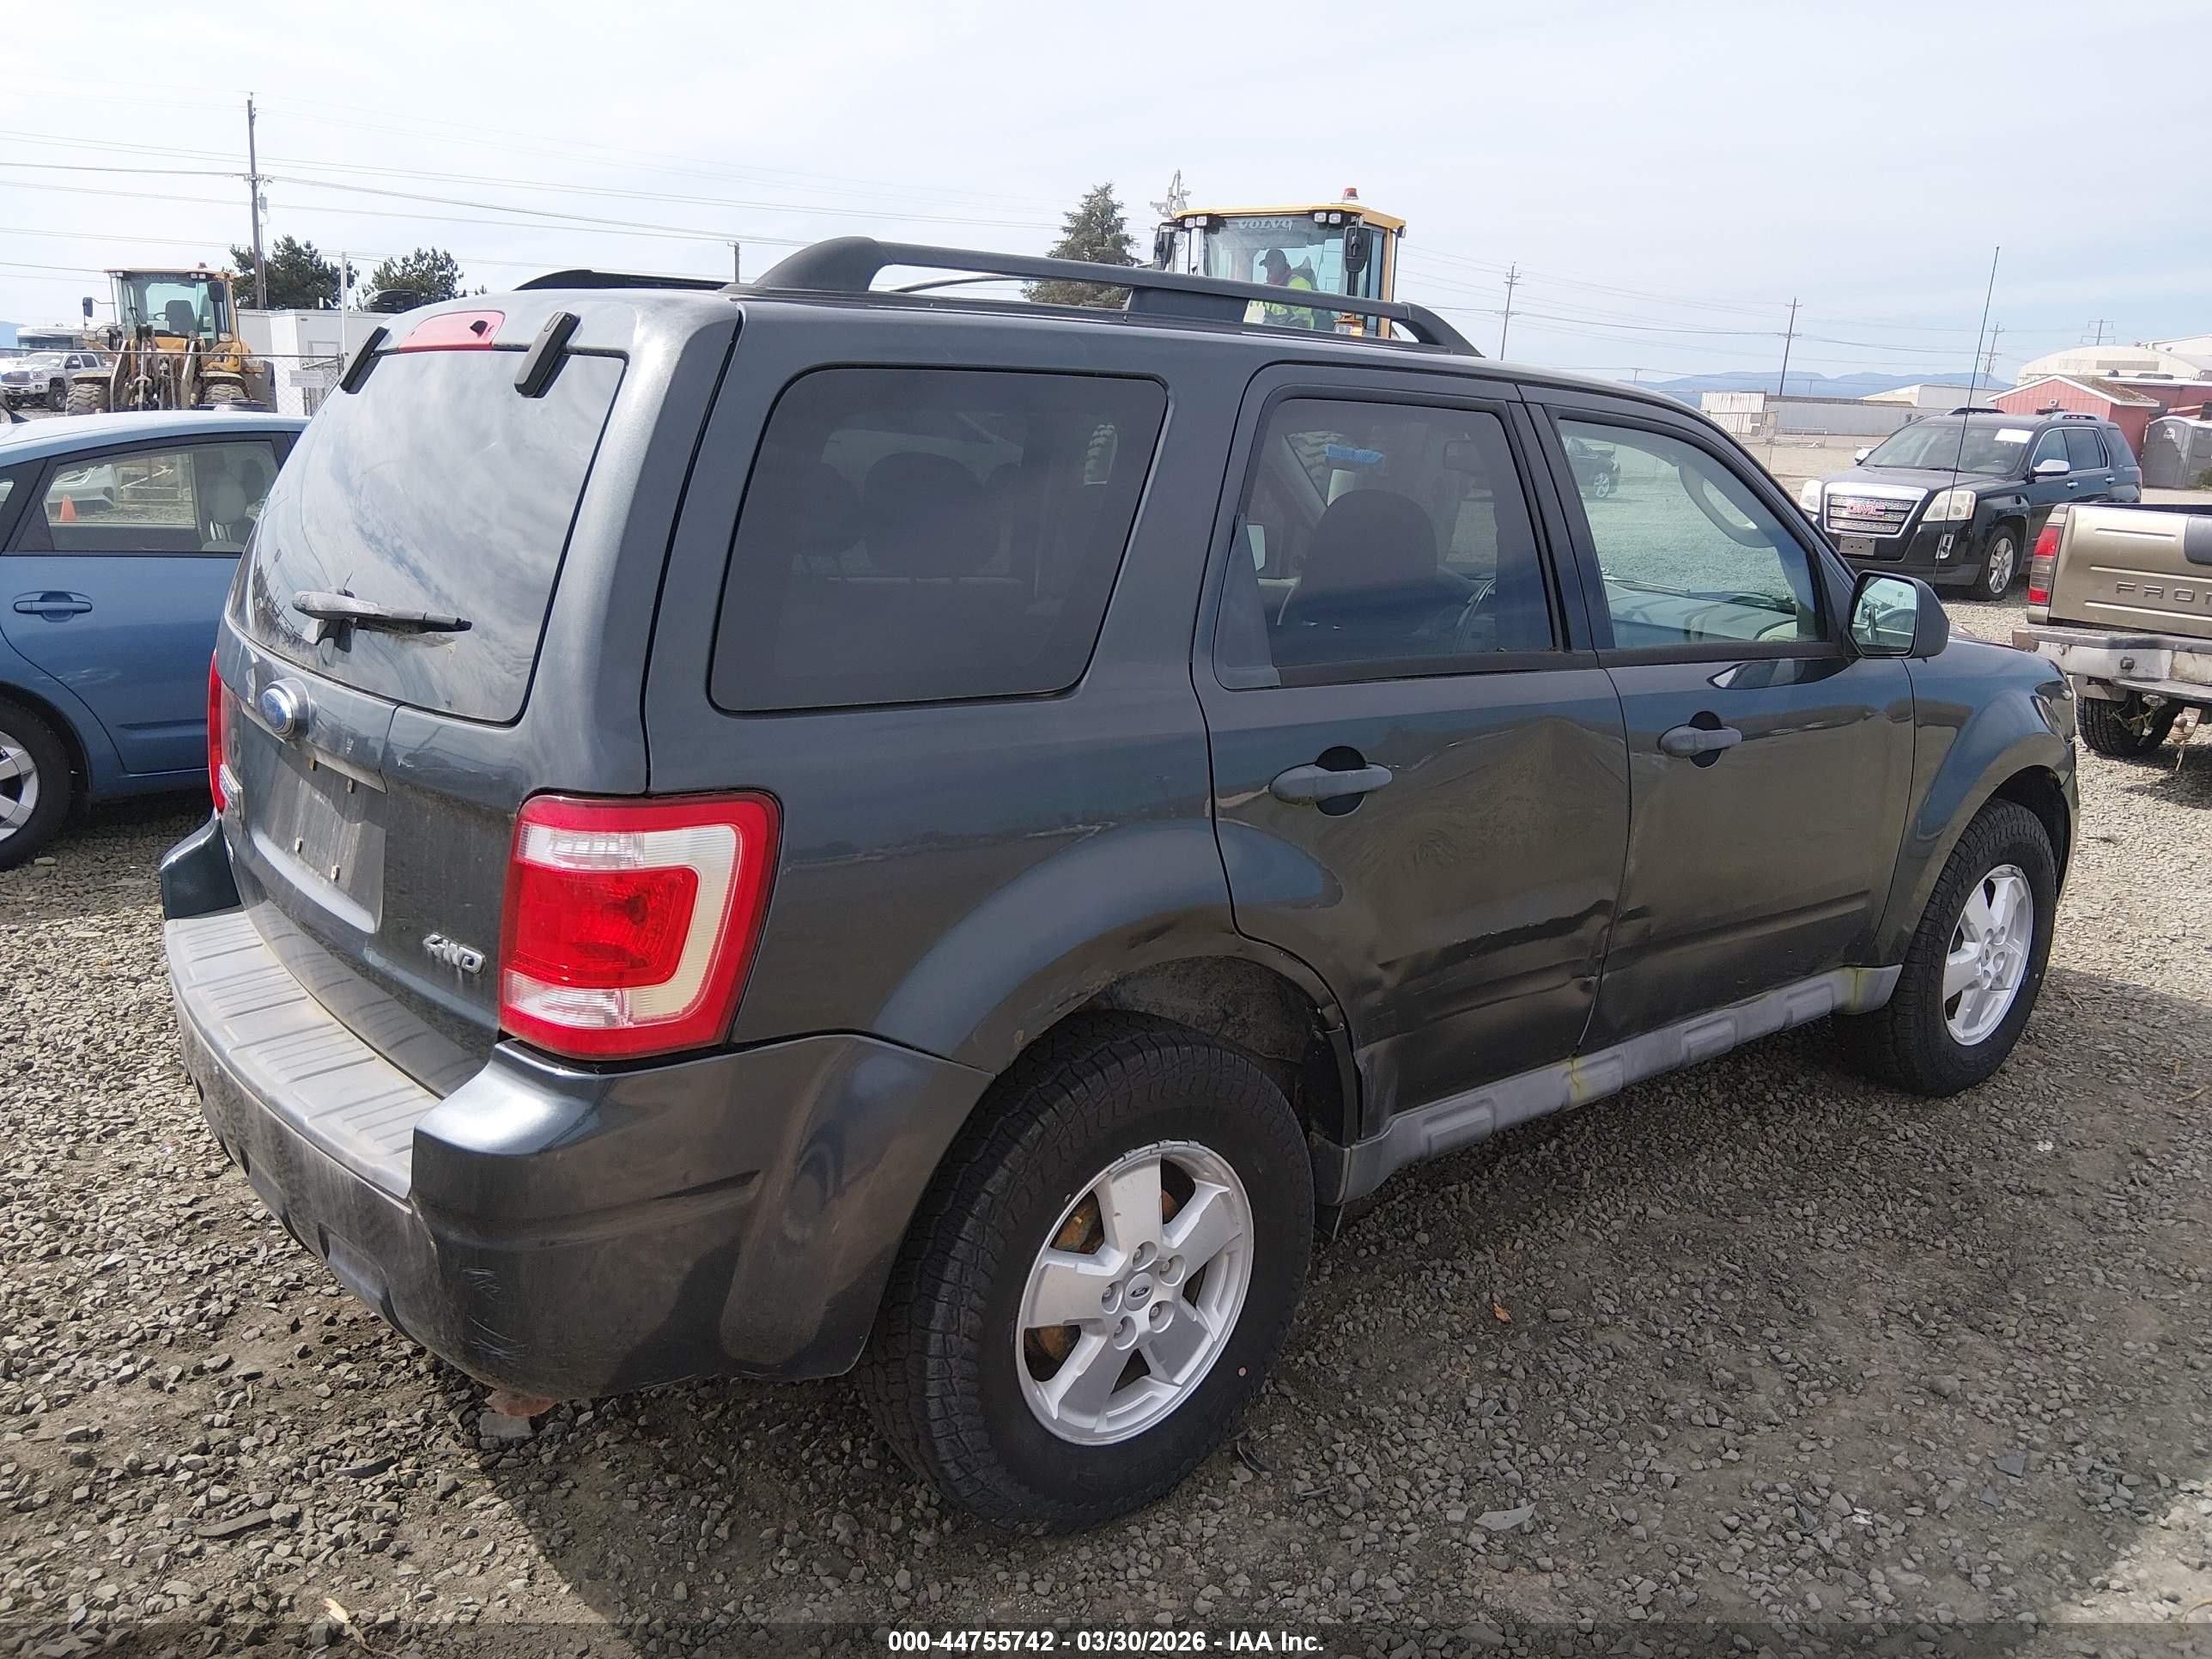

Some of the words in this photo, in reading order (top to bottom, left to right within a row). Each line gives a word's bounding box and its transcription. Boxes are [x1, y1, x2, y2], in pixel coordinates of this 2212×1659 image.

[1237, 219, 1293, 229] VOLVO
[1847, 502, 1887, 515] GMC
[422, 933, 485, 974] 4WD
